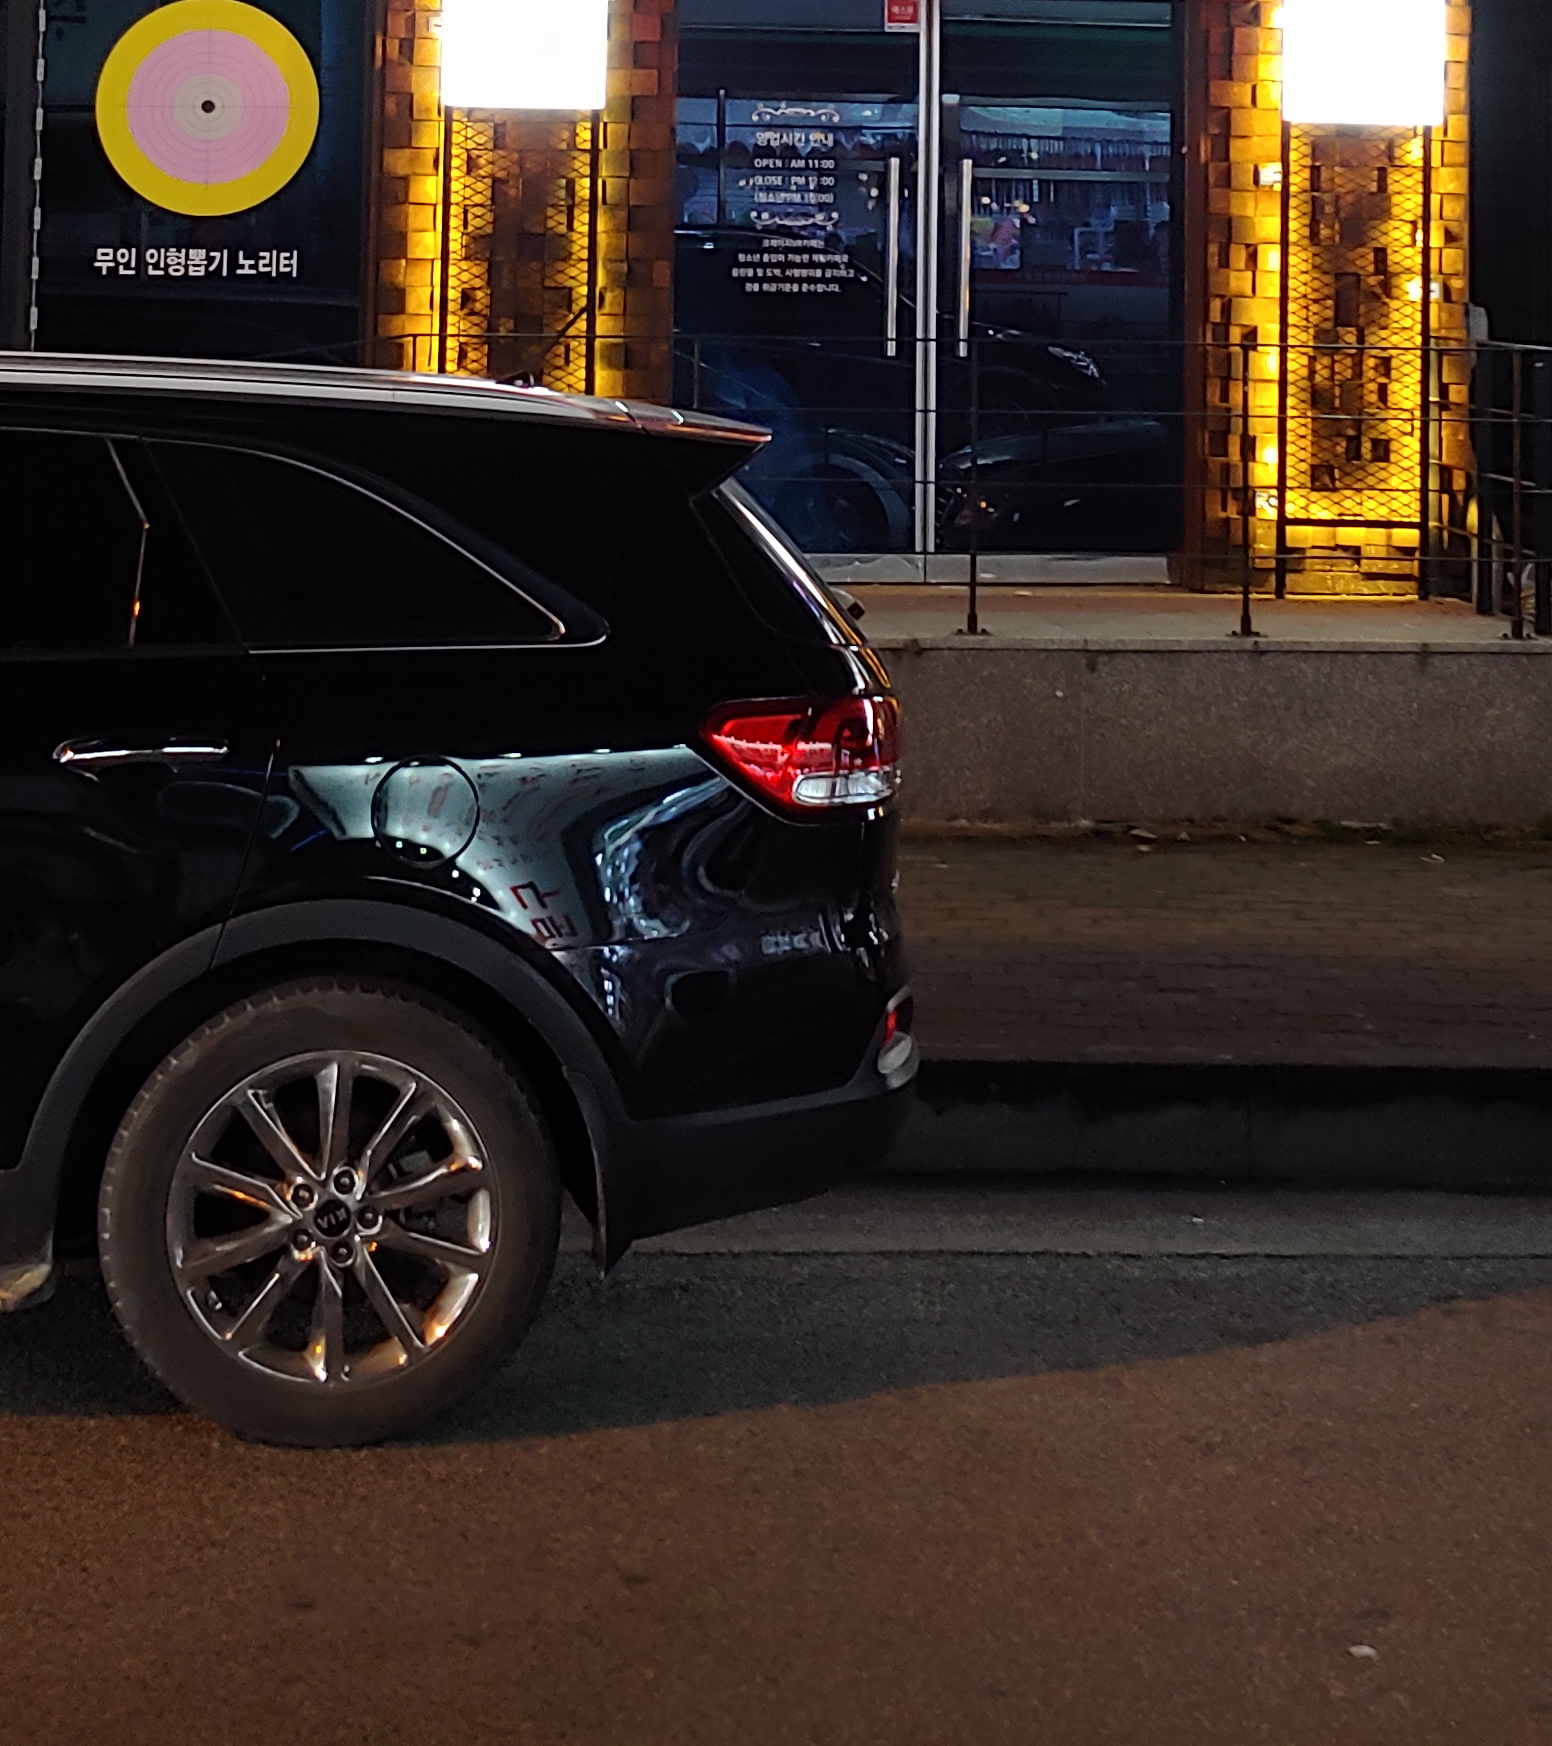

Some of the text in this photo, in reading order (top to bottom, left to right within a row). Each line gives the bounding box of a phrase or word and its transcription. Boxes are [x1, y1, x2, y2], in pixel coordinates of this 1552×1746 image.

[93, 247, 298, 278] 무인 인형뽑기 노리터
